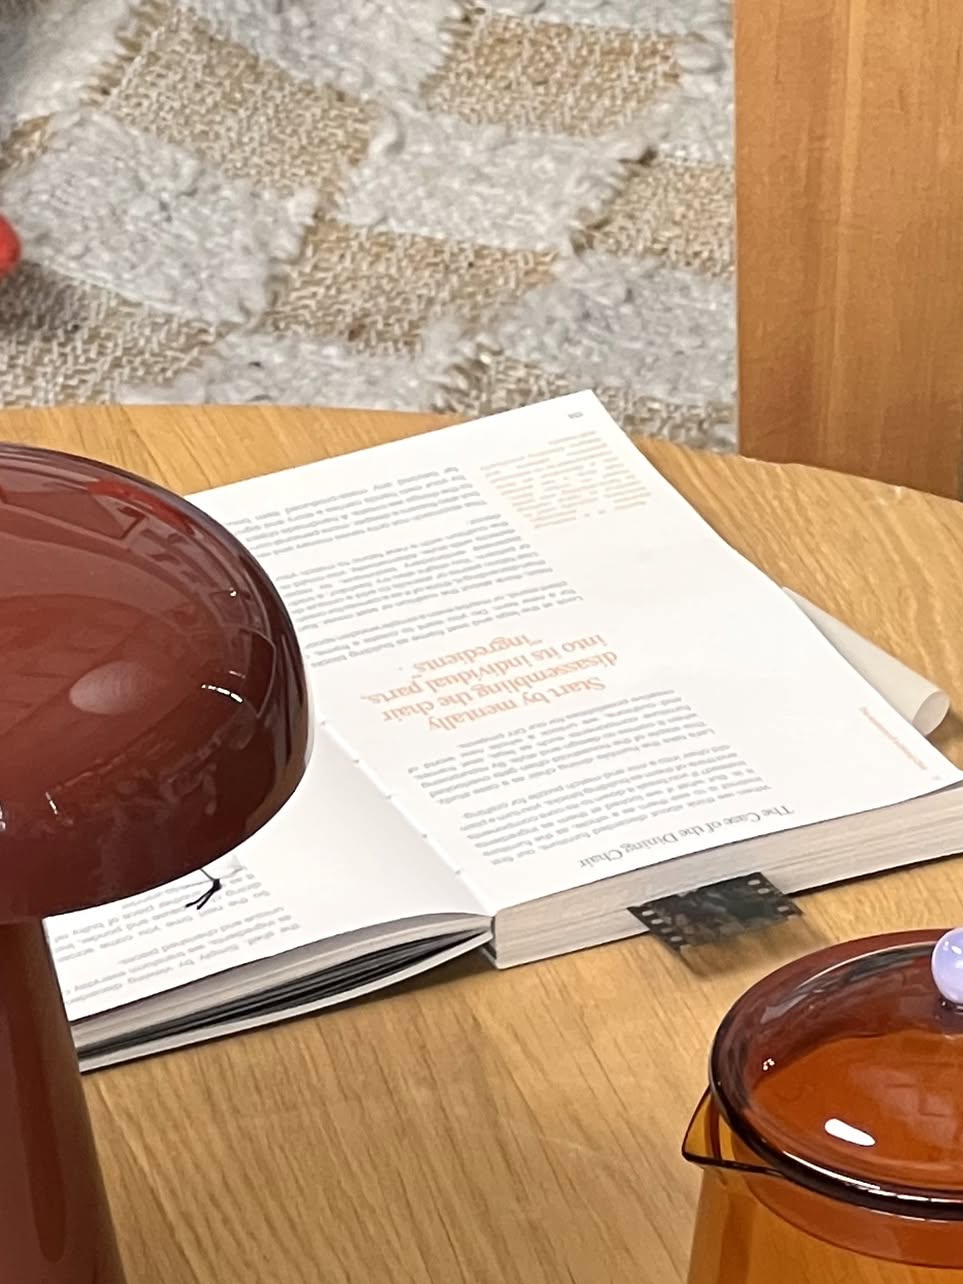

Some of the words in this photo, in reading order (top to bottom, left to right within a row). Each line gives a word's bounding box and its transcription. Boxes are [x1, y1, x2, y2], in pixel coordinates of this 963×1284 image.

[561, 634, 607, 653] into
[530, 646, 563, 661] its
[425, 655, 532, 693] individual
[471, 652, 617, 697] disassembling
[548, 677, 606, 698] Start
[437, 691, 474, 707] the
[521, 691, 551, 706] by
[382, 700, 435, 722] chair
[428, 700, 518, 731] mentally
[722, 812, 761, 825] Case
[761, 805, 795, 817] The
[678, 825, 705, 837] the
[704, 820, 723, 833] of
[620, 832, 679, 853] Dining
[579, 849, 624, 868] Chair
